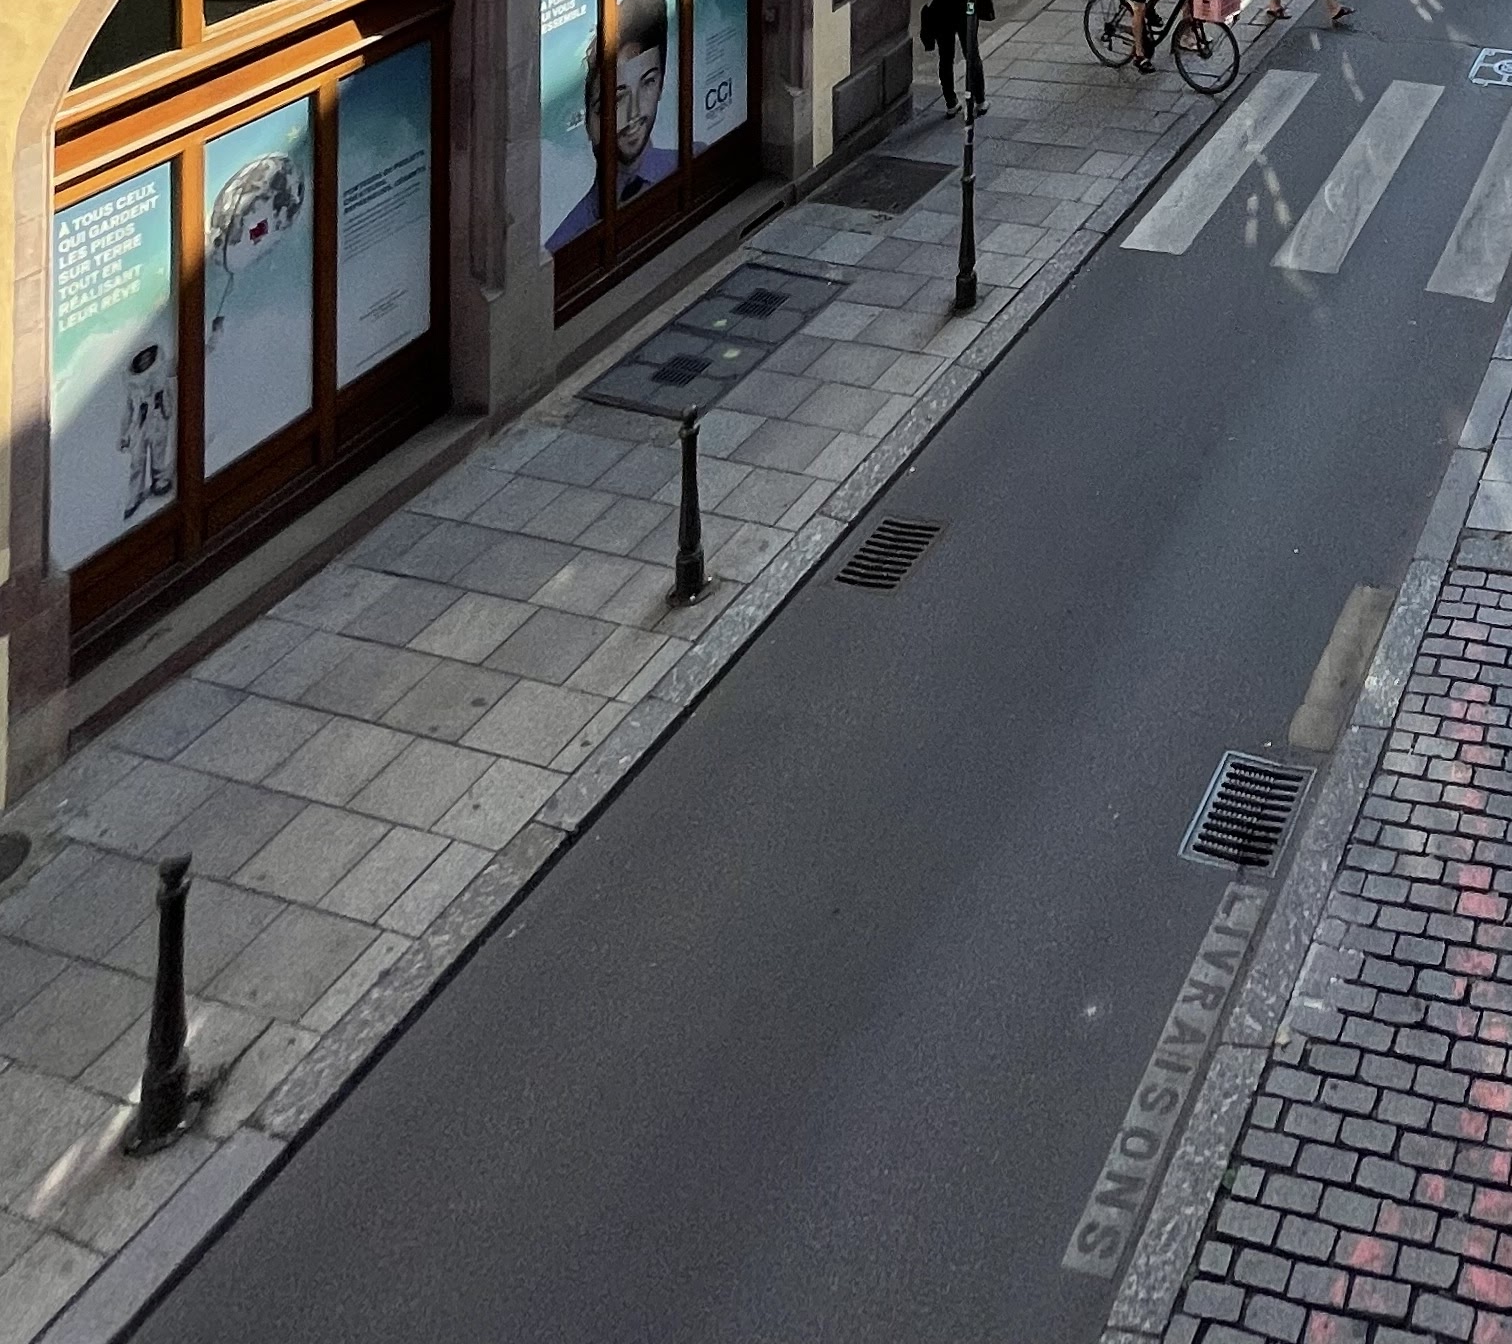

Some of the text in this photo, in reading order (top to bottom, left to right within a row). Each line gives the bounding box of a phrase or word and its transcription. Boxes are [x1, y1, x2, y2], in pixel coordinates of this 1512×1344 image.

[541, 4, 587, 35] ESSEMBLE
[58, 182, 156, 239] À TOUS CEUX
[58, 194, 160, 253] QUI GARDENT
[58, 233, 142, 285] SUR TERRE
[59, 222, 136, 269] LES PIEDS
[58, 259, 122, 301] TOUT EN
[58, 264, 142, 317] RÉALISANT
[58, 279, 141, 333] LEUR RÊVE
[1076, 887, 1262, 1259] LIVRAISONS
